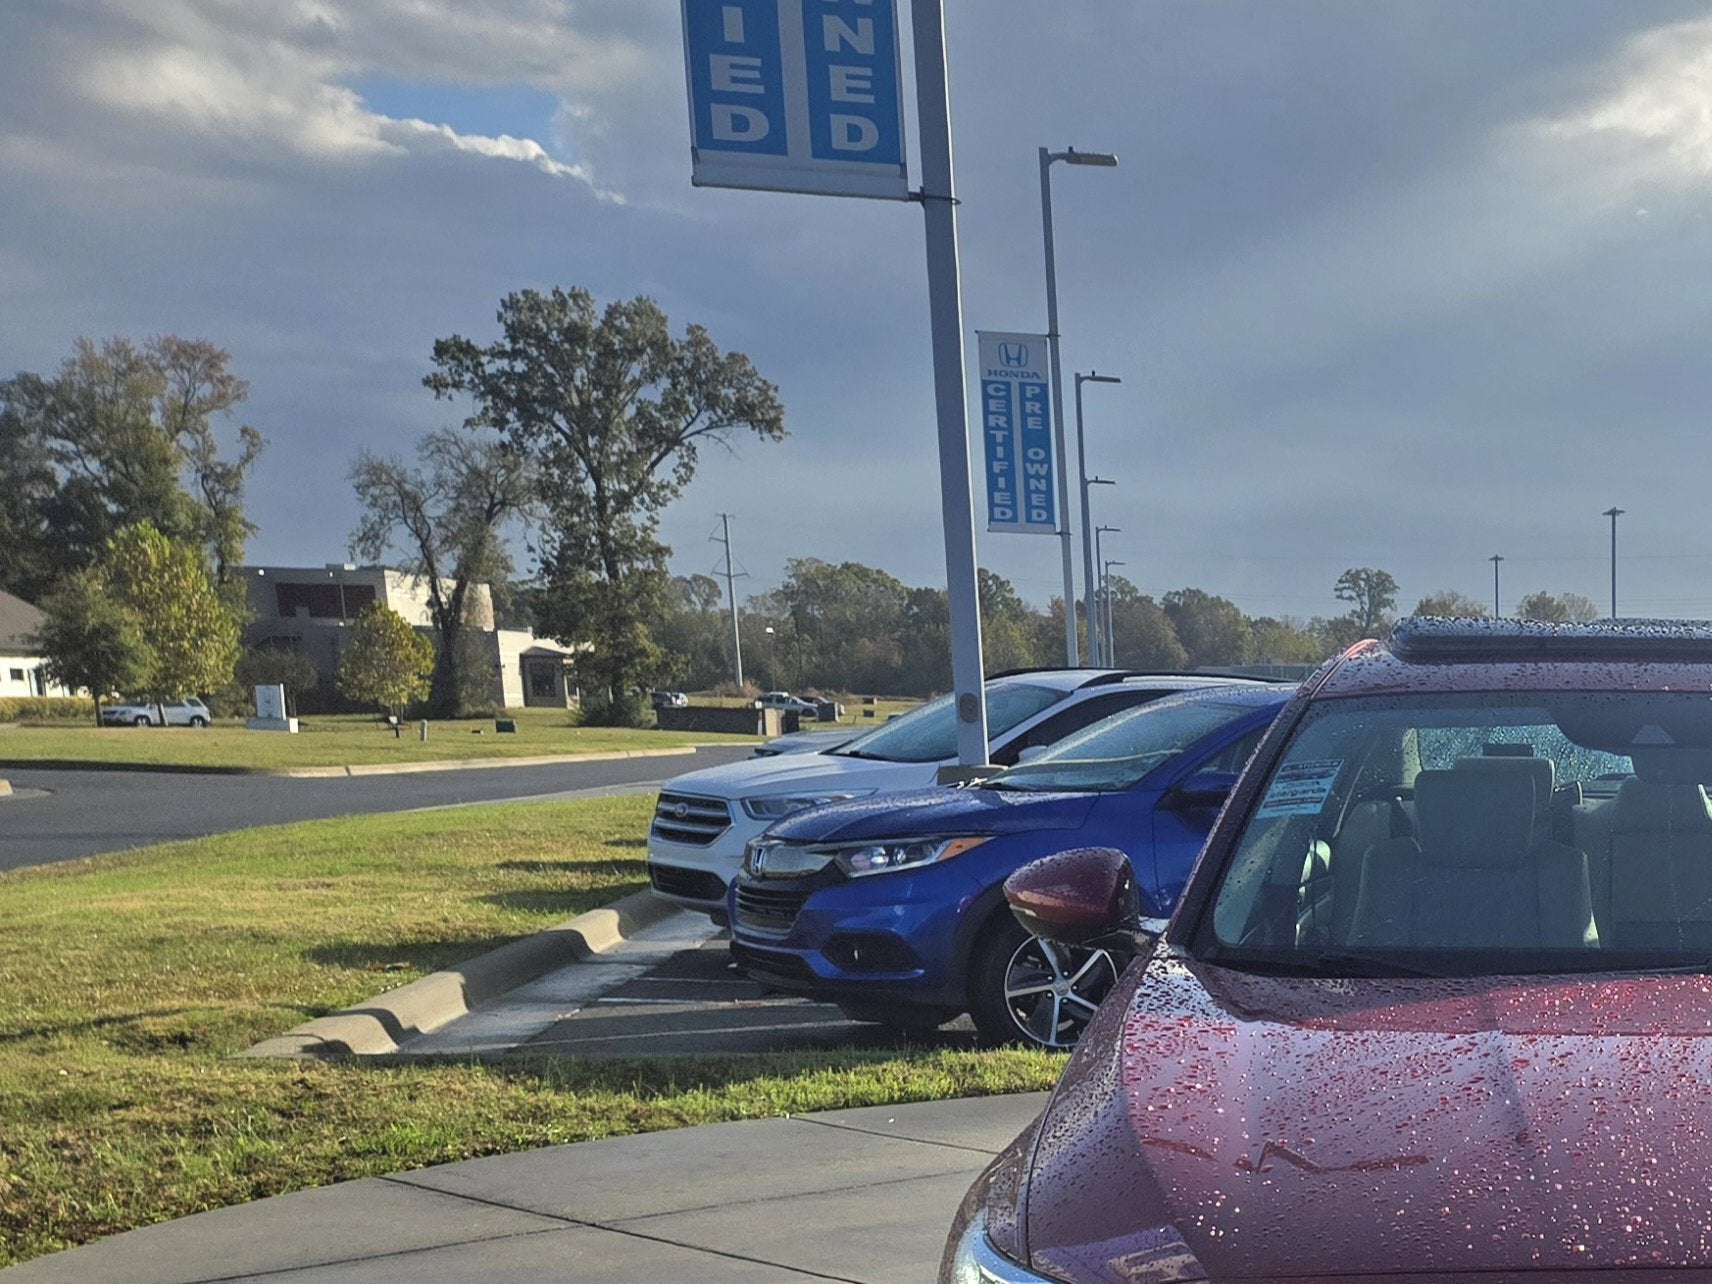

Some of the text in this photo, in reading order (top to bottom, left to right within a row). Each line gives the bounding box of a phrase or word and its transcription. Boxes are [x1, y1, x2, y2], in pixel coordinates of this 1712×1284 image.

[822, 0, 879, 151] NED
[987, 369, 1041, 379] HONDA
[987, 384, 1013, 519] CERTIFIED
[1025, 385, 1048, 520] PRE OWNED
